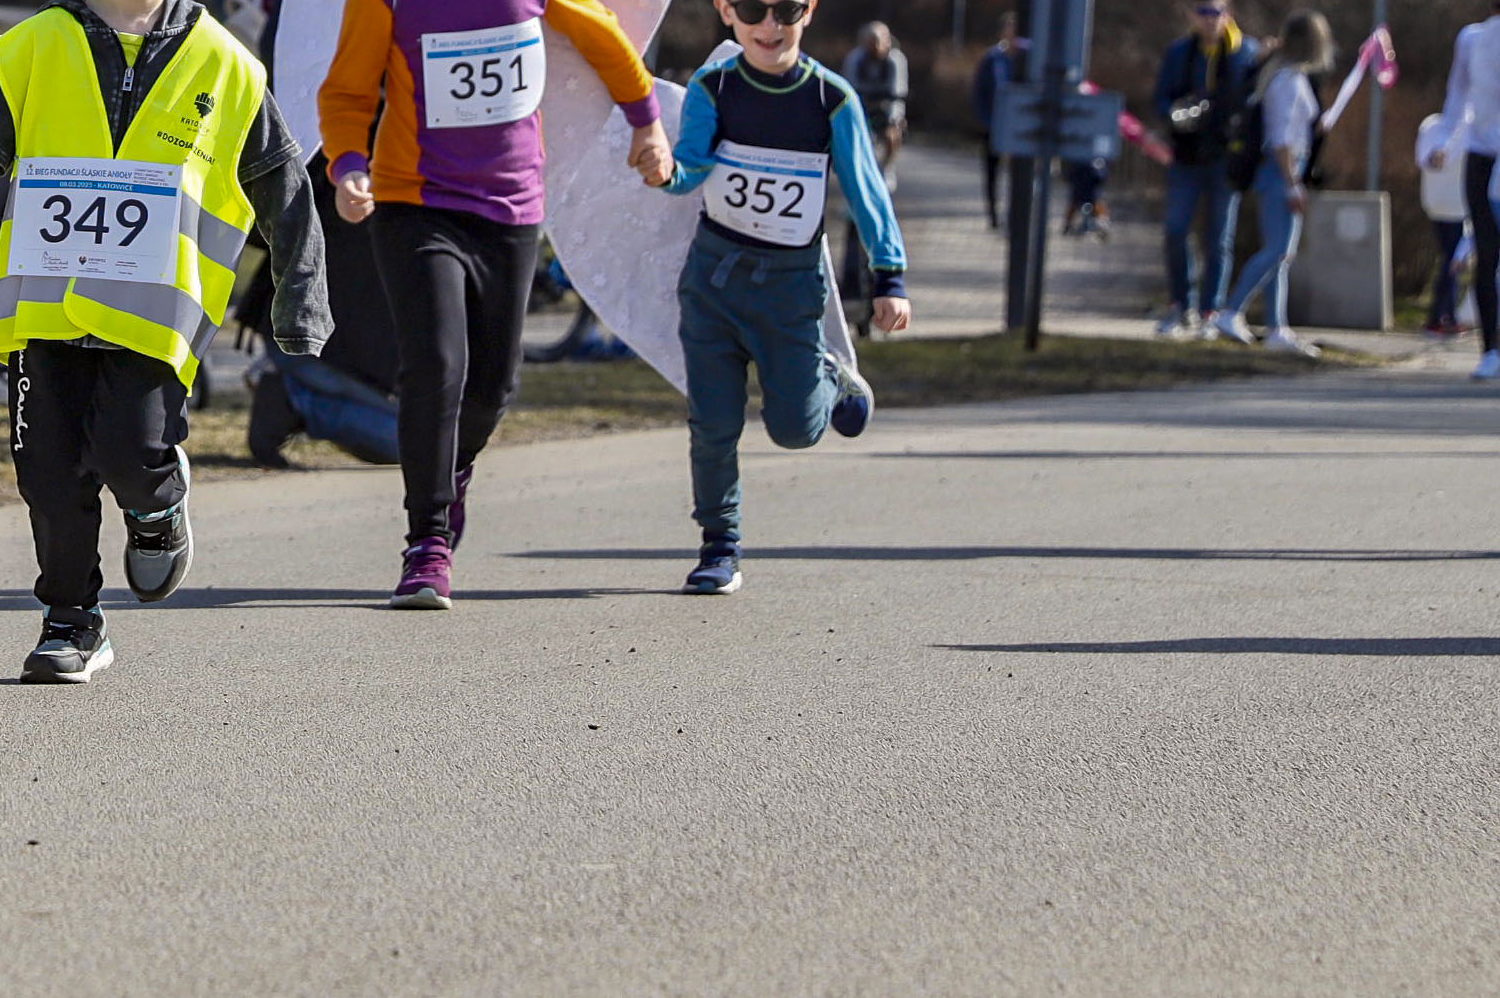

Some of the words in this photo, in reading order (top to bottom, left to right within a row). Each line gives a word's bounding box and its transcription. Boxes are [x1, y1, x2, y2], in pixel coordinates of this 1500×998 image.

[450, 54, 528, 100] 351
[35, 168, 49, 176] BIEG
[50, 168, 80, 177] FUNDACJI
[107, 170, 133, 180] ANIOŁY
[97, 182, 133, 192] KATOWICE
[724, 172, 804, 218] 352
[39, 194, 148, 247] 349
